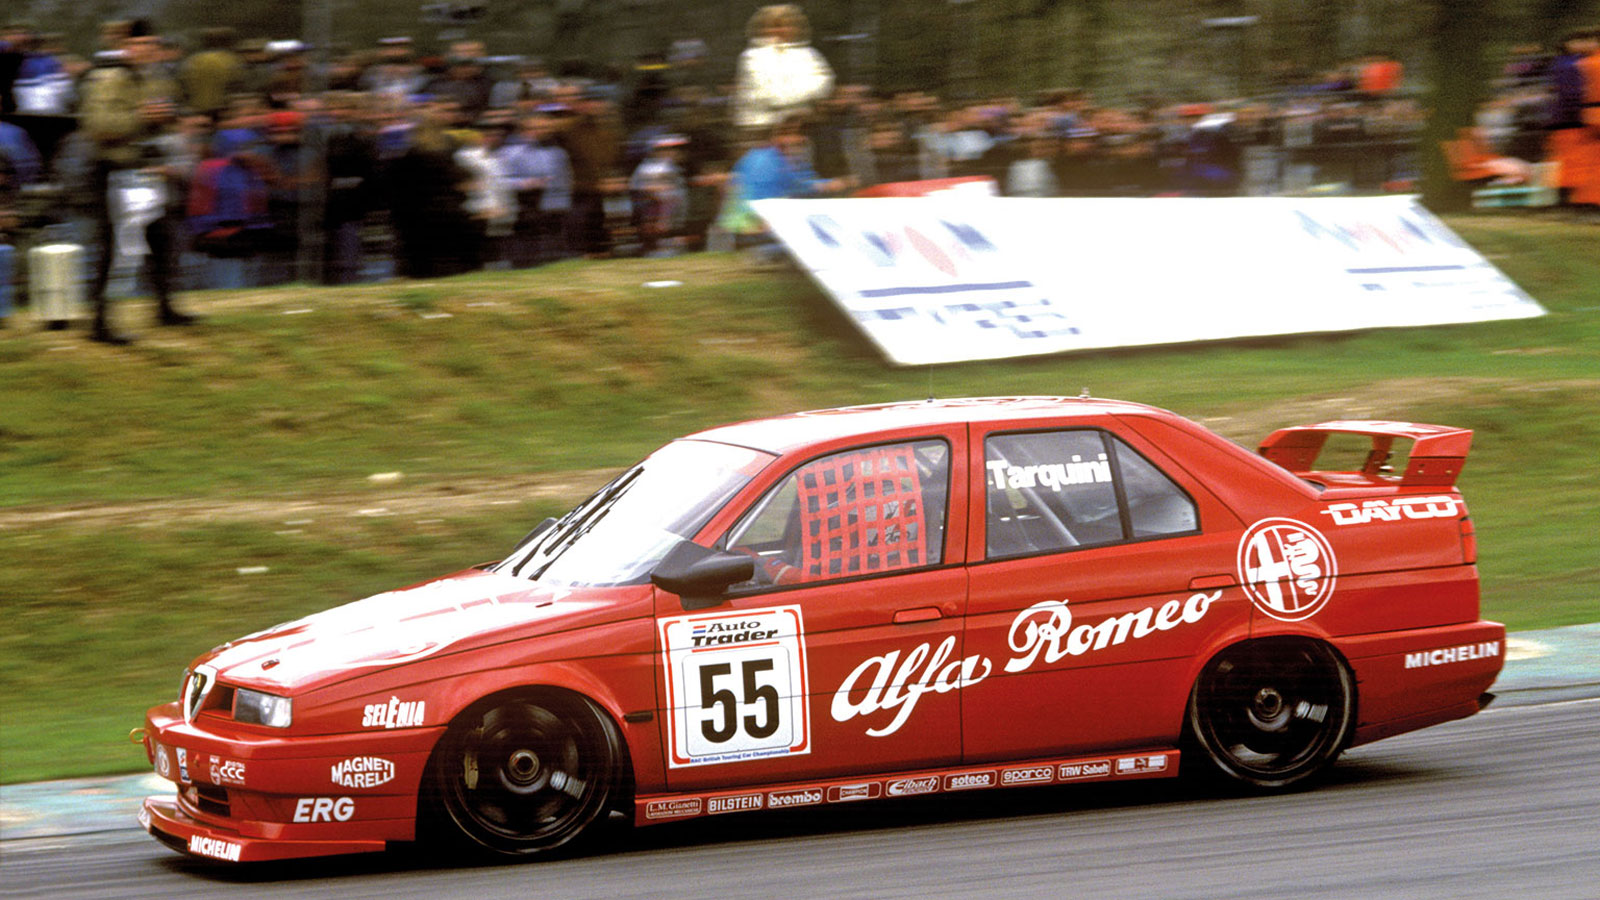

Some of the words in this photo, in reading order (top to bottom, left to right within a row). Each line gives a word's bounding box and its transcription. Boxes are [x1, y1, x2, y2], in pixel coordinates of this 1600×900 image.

[986, 453, 1112, 492] Tarquini
[1320, 496, 1464, 526] DAYCO
[707, 620, 761, 633] Auto
[691, 629, 779, 647] Trader
[830, 635, 992, 737] Alfa
[1003, 590, 1223, 673] Romeo
[1404, 641, 1500, 669] MICHELIN
[699, 658, 780, 744] 55
[331, 756, 395, 780] MAGNETI
[1061, 766, 1081, 778] TRW
[1082, 763, 1109, 776] Sabelt
[331, 770, 395, 788] MARELLI
[889, 777, 937, 795] Eibach
[951, 774, 990, 786] soteco
[709, 796, 762, 812] BILSTEIN
[769, 791, 821, 806] brembo
[293, 798, 355, 823] ERG
[189, 835, 242, 862] MICHELIN
